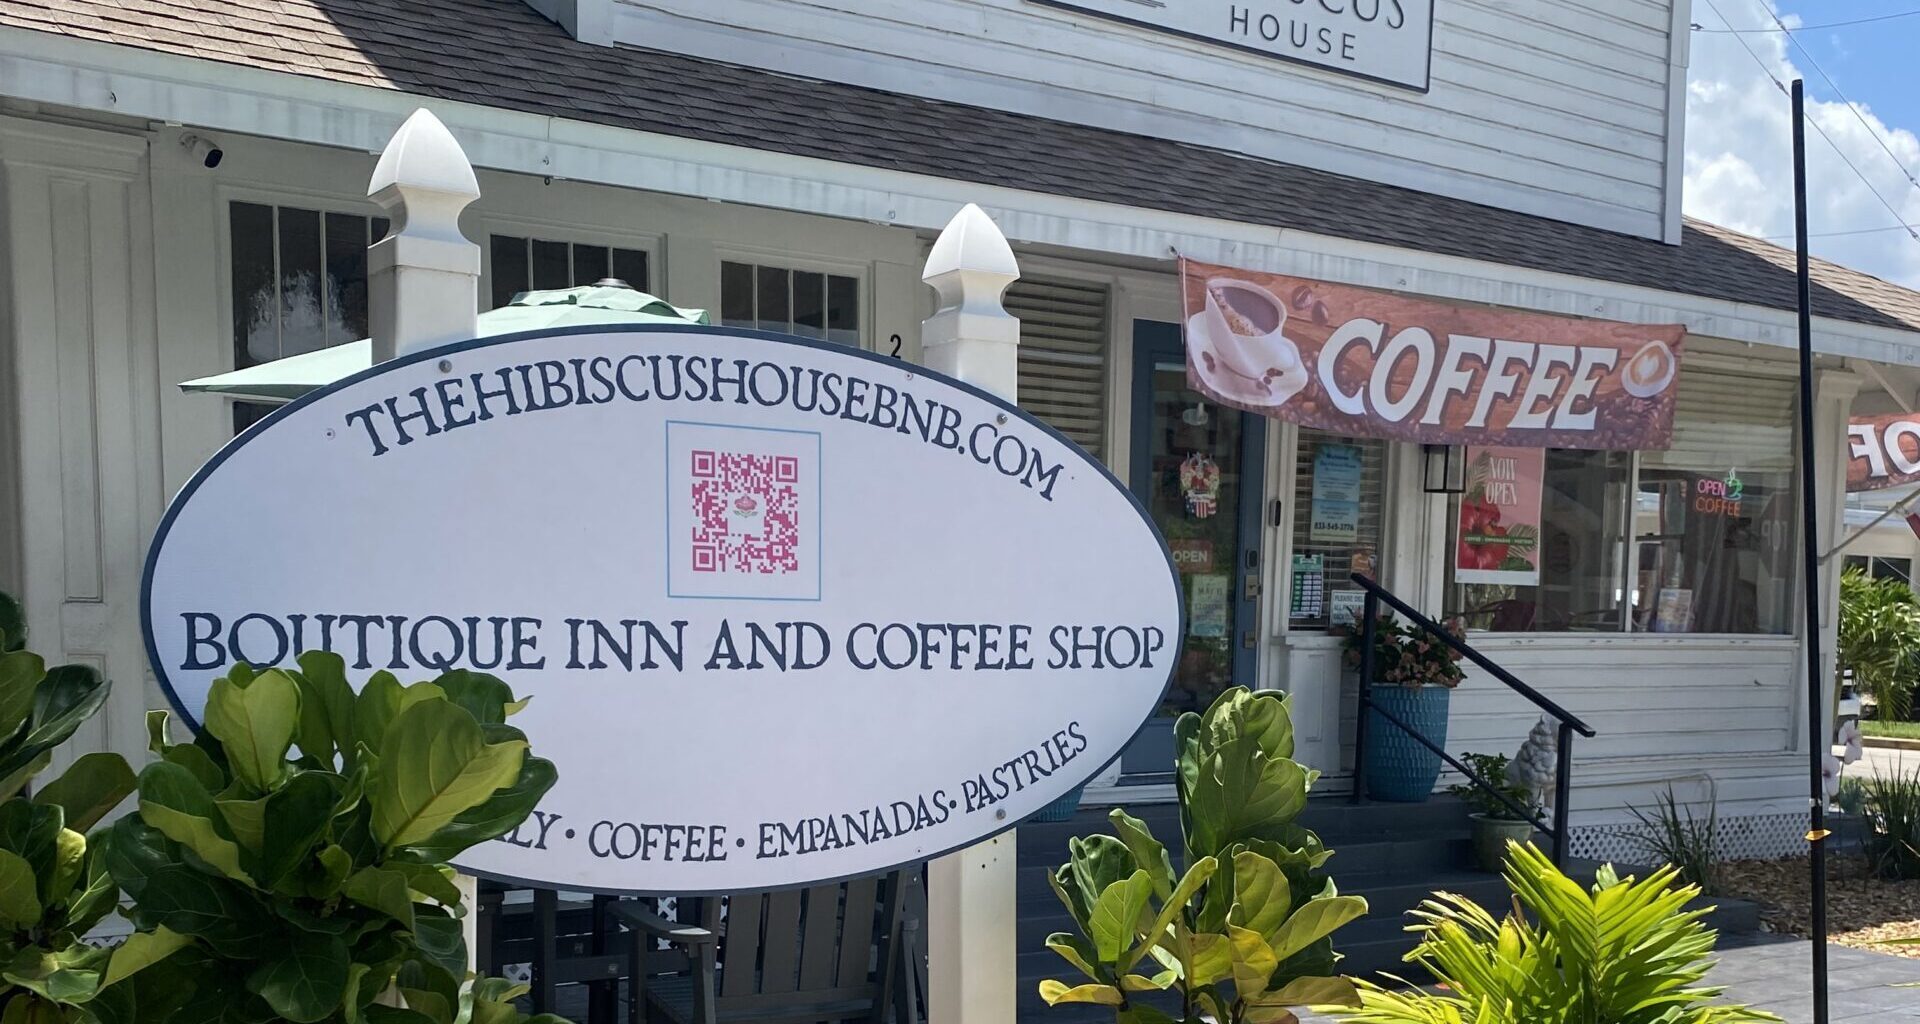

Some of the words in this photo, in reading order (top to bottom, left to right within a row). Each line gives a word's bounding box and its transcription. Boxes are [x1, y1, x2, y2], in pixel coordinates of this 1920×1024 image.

[1230, 5, 1356, 61] HOUSE
[890, 333, 902, 360] 2
[1318, 318, 1618, 431] COFFEE
[345, 354, 1064, 501] THEHIBISCUSHOUSEBNB.COM
[1489, 456, 1518, 481] NOW
[1485, 481, 1518, 505] OPEN
[1697, 478, 1727, 497] OPEN
[1695, 496, 1742, 517] COFFEE
[1172, 550, 1208, 562] OPEN
[180, 612, 545, 671] BOUTIQUE
[564, 618, 689, 672] INN
[704, 618, 831, 672] AND
[846, 622, 1034, 671] COFFEE
[1047, 625, 1164, 669] SHOP
[494, 811, 562, 850] LY
[588, 821, 728, 862] COFFEE
[756, 789, 949, 859] EMPANADAS
[961, 721, 1087, 813] PASTRIES
